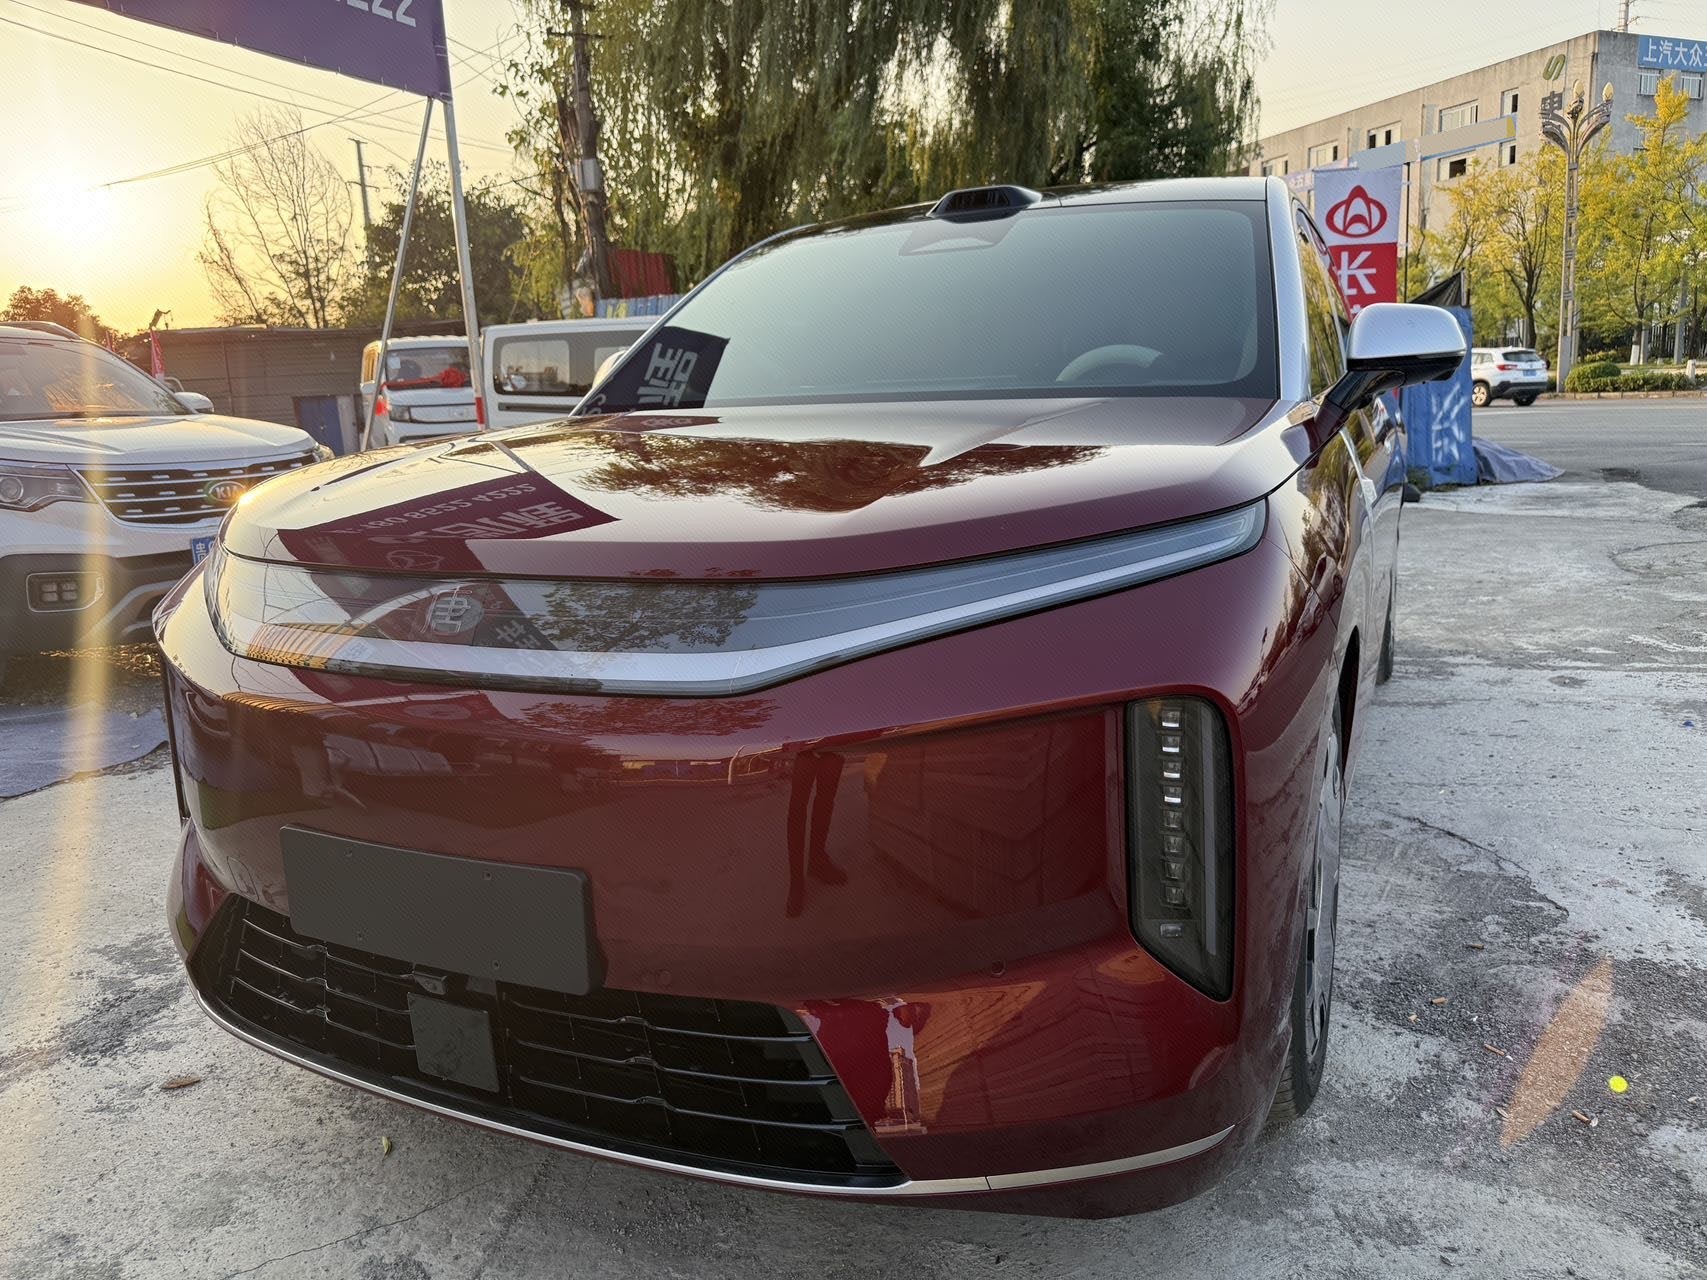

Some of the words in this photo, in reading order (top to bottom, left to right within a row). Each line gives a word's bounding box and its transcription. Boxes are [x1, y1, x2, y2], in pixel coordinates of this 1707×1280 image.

[1643, 38, 1707, 67] 上汽大众
[1337, 251, 1376, 313] 长
